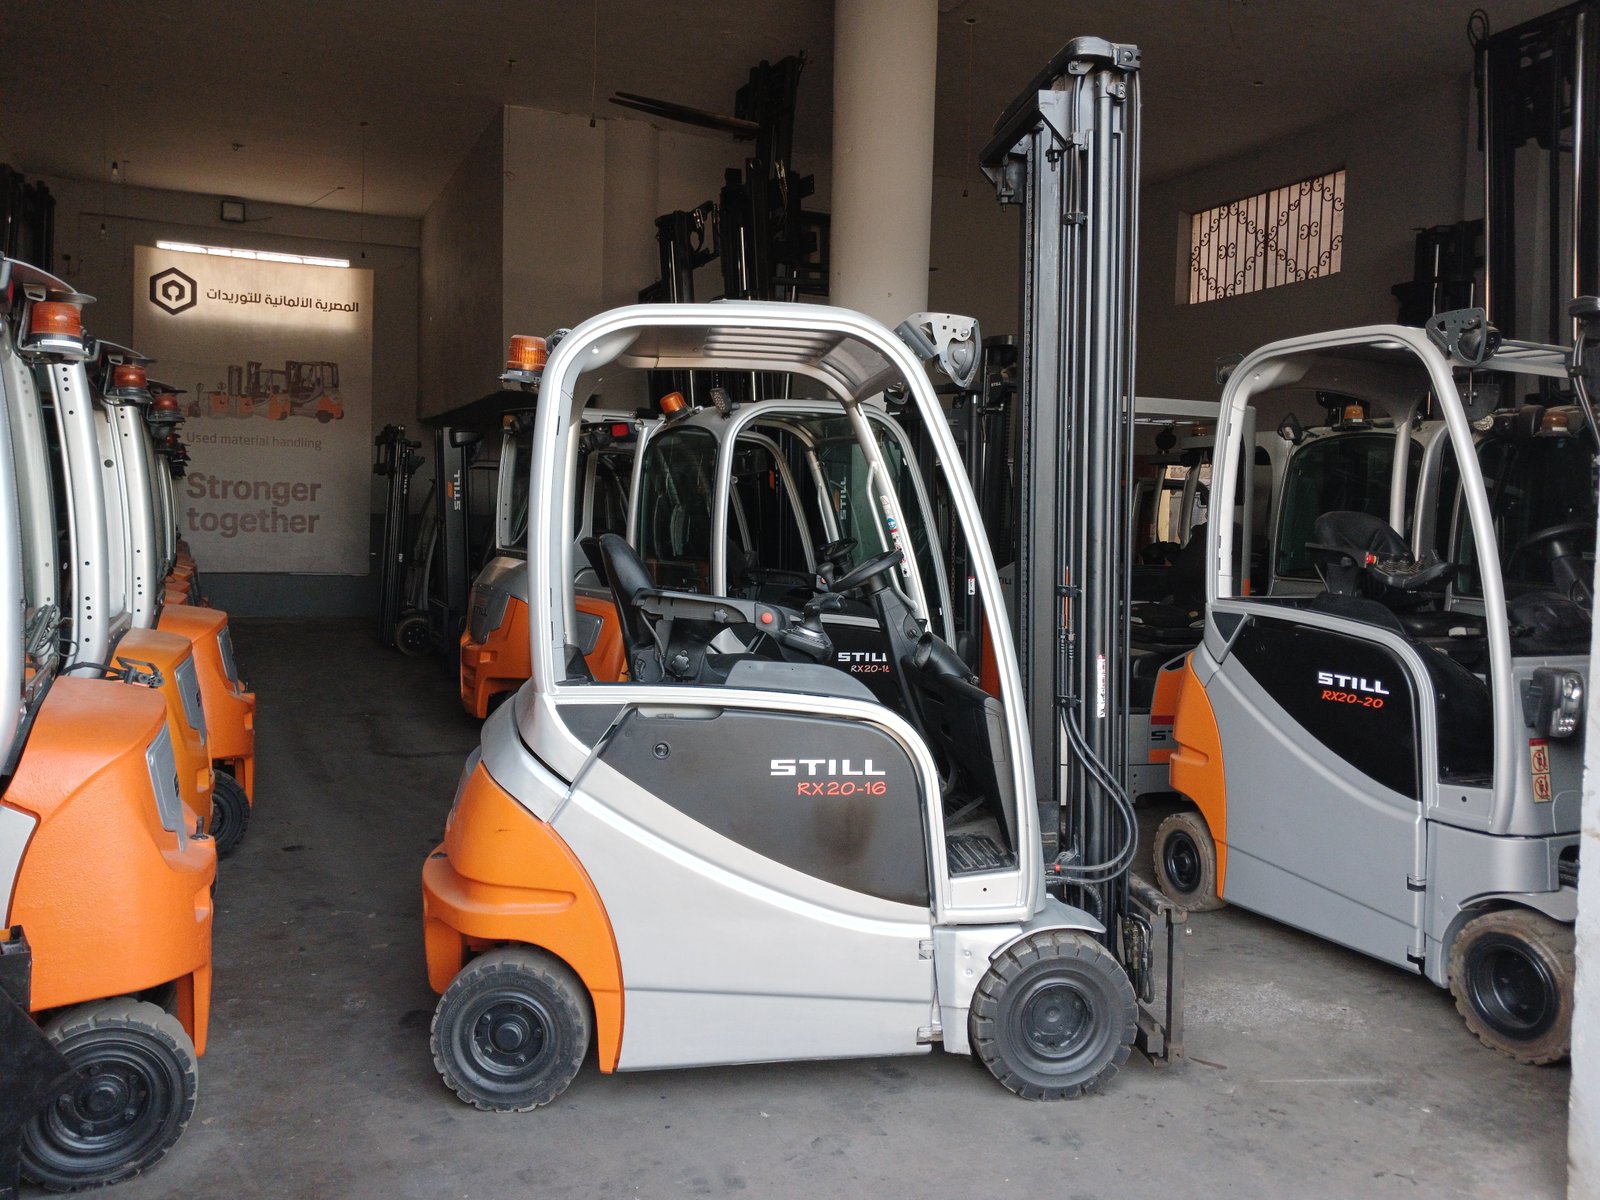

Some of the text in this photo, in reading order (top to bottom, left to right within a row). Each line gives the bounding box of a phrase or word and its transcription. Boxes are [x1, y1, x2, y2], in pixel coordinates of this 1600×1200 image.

[206, 288, 261, 304] للتوريدات
[315, 299, 359, 312] المصرية
[187, 432, 322, 451] Used material handling
[186, 472, 322, 507] Stronger
[453, 469, 461, 511] STILL
[186, 507, 320, 538] together
[1318, 671, 1390, 695] STILL
[1321, 689, 1384, 709] RX20-20
[770, 759, 886, 776] STILL
[797, 781, 887, 796] RX20-16
